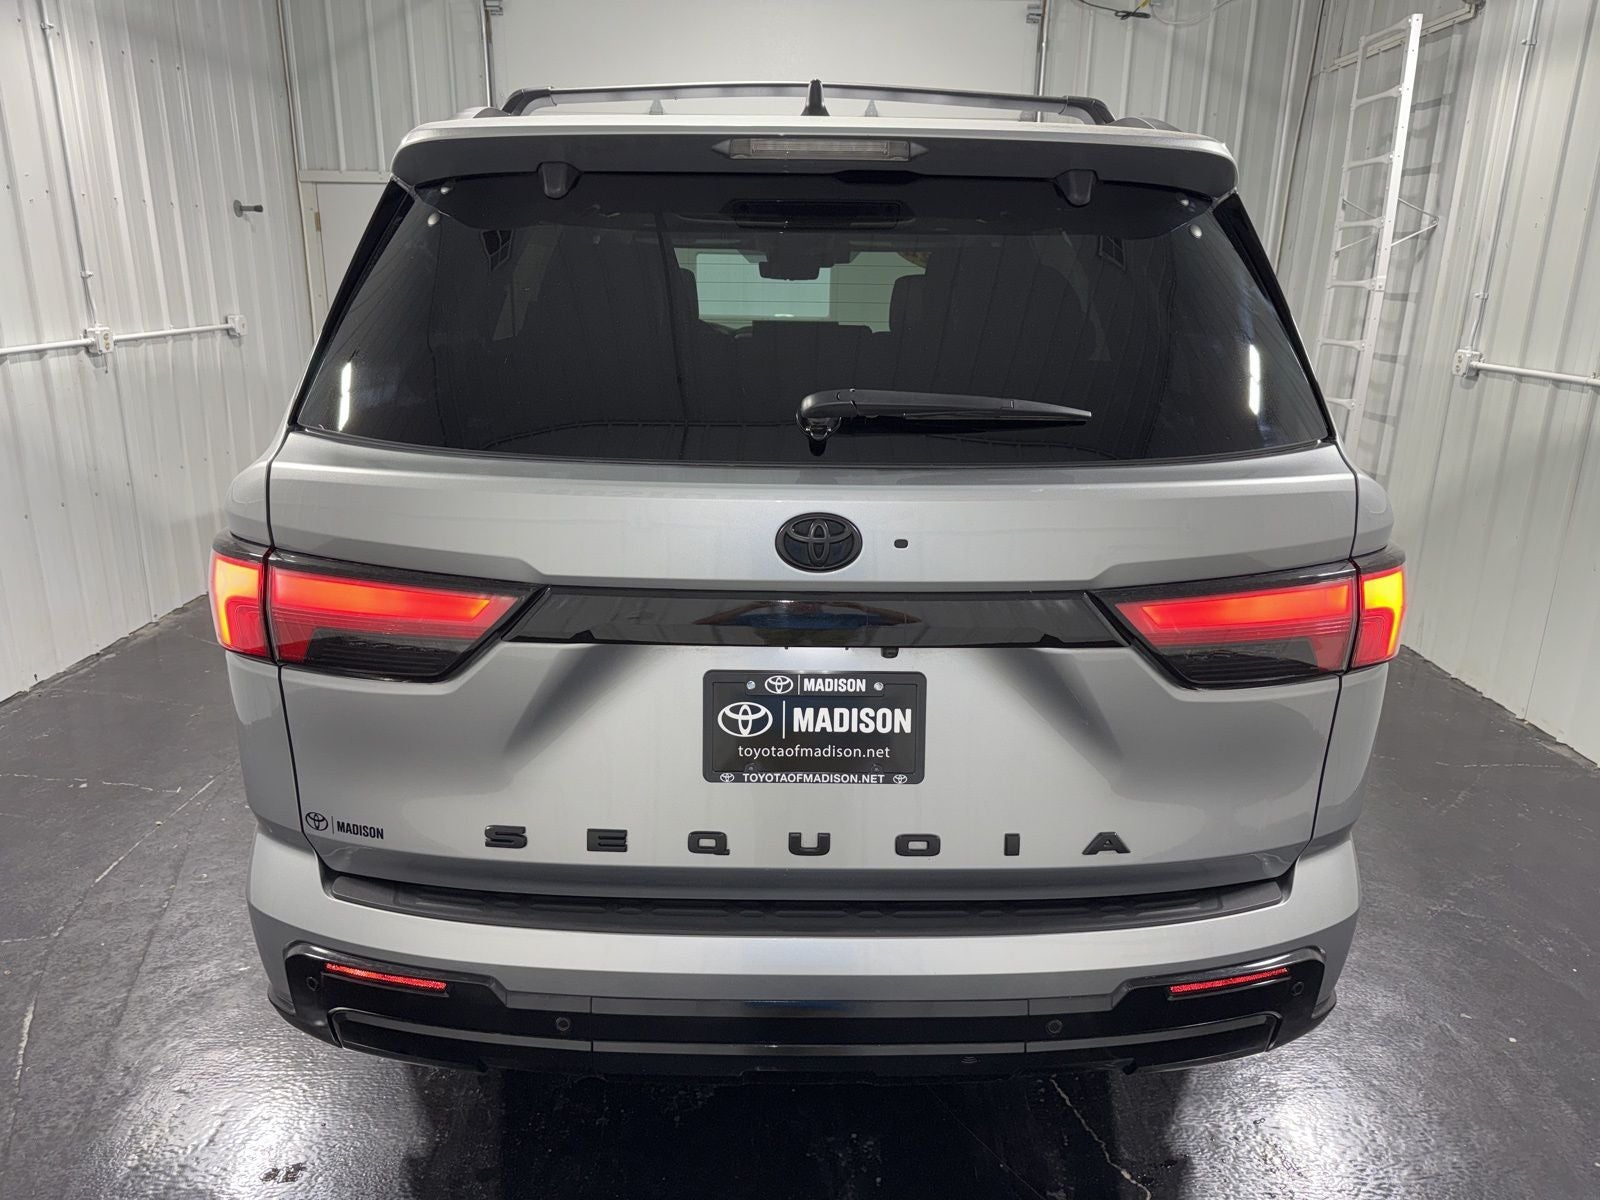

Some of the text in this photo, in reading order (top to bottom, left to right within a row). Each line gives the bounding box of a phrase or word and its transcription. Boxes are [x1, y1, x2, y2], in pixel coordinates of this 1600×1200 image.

[803, 678, 866, 693] MADISON
[793, 707, 912, 734] MADISON
[738, 745, 890, 760] toyotaofmadison.net
[742, 773, 886, 784] TOYOTAOFMADISON.NET
[336, 820, 385, 840] MADISON
[484, 824, 1131, 857] SEQUOIA
